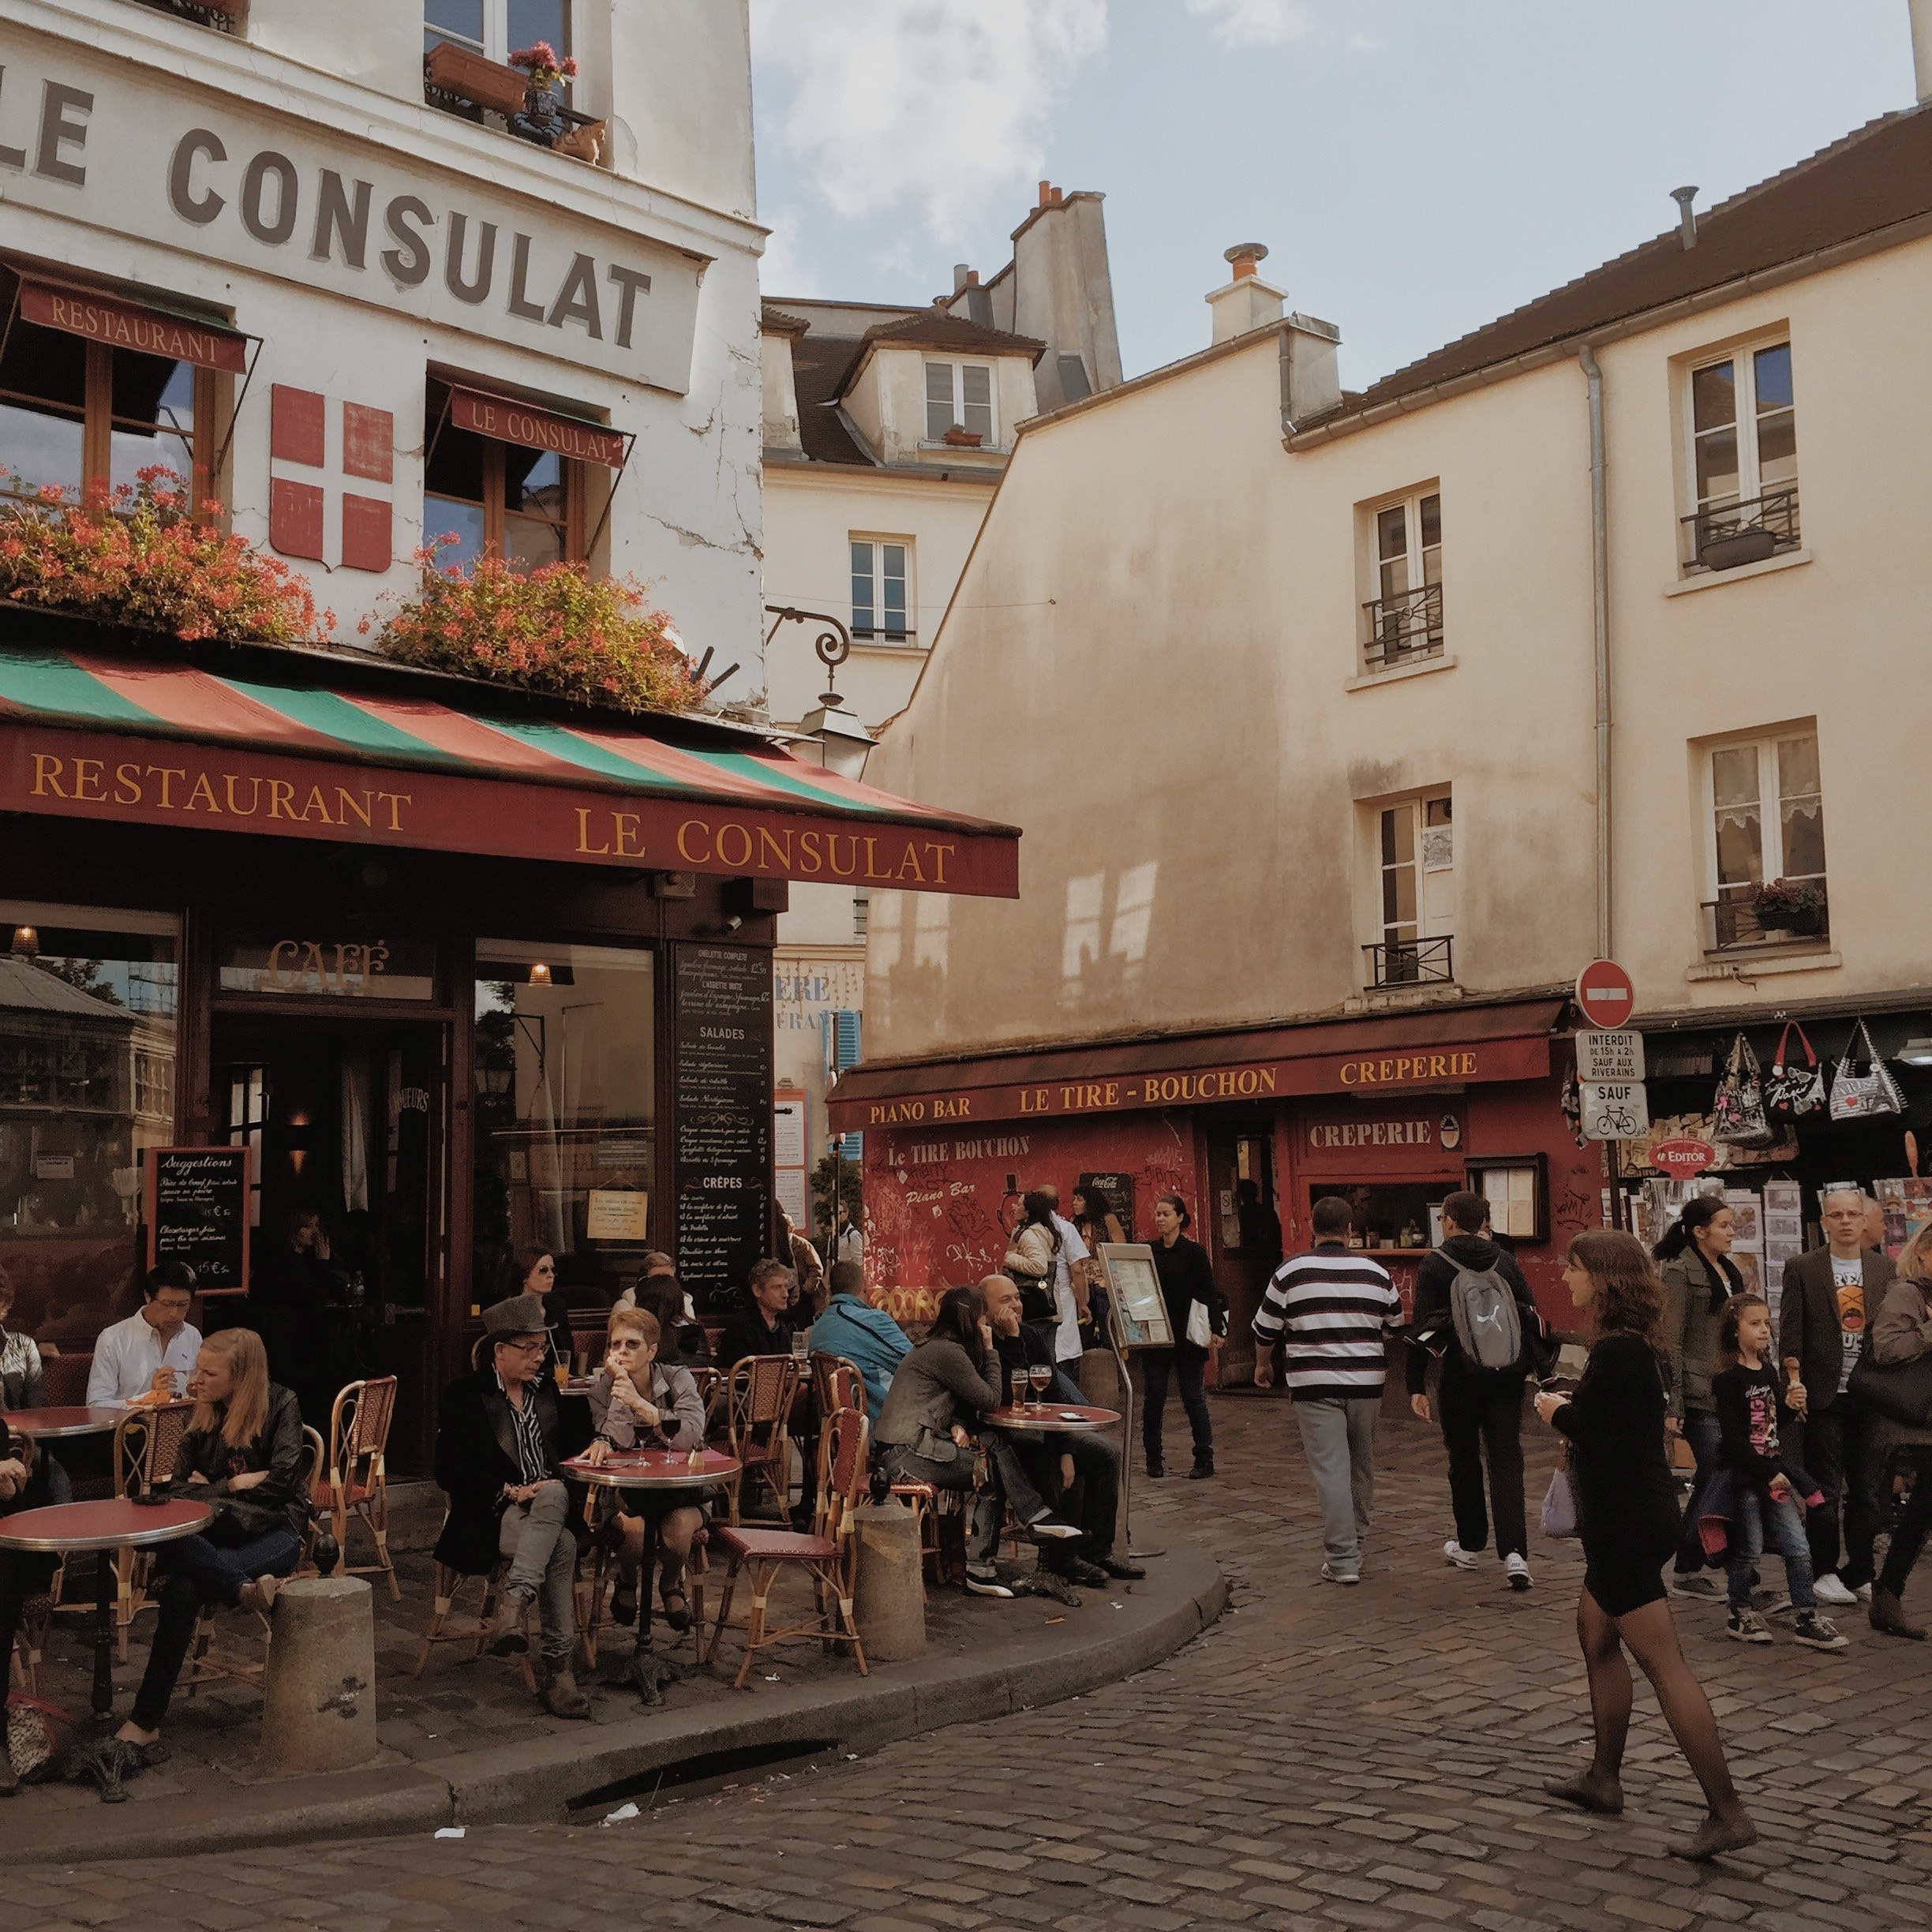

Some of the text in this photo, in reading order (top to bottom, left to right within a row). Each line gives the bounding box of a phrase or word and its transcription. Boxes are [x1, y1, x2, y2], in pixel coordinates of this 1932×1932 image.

[167, 127, 652, 350] CONSULAT
[52, 295, 220, 362] RESTAURANT
[471, 402, 610, 460] LE CONSULAT
[29, 753, 412, 831] RESTAURANT
[575, 807, 955, 884] LE CONSULAT
[267, 939, 390, 988] CAFÉ
[700, 1027, 745, 1039] SALADES
[1589, 1035, 1633, 1046] INTERDIT
[1601, 1047, 1614, 1056] 15h
[1624, 1047, 1634, 1056] 2h
[1340, 1052, 1477, 1084] CREPERIE
[1592, 1068, 1635, 1076] RIVERAINS
[1020, 1088, 1050, 1114] LE
[1061, 1082, 1119, 1110] TIRE
[1144, 1067, 1279, 1104] BOUCHON
[1598, 1087, 1631, 1099] SAUF
[870, 1097, 971, 1125] PIANO BAR
[1309, 1121, 1432, 1148] CREPERIE
[888, 1136, 1031, 1166] Le TIRE BOUCHON
[1668, 1151, 1705, 1162] EDITOR
[161, 1155, 232, 1176] Suggestions
[703, 1175, 743, 1189] CRÊPES
[906, 1181, 975, 1207] Piano Bar
